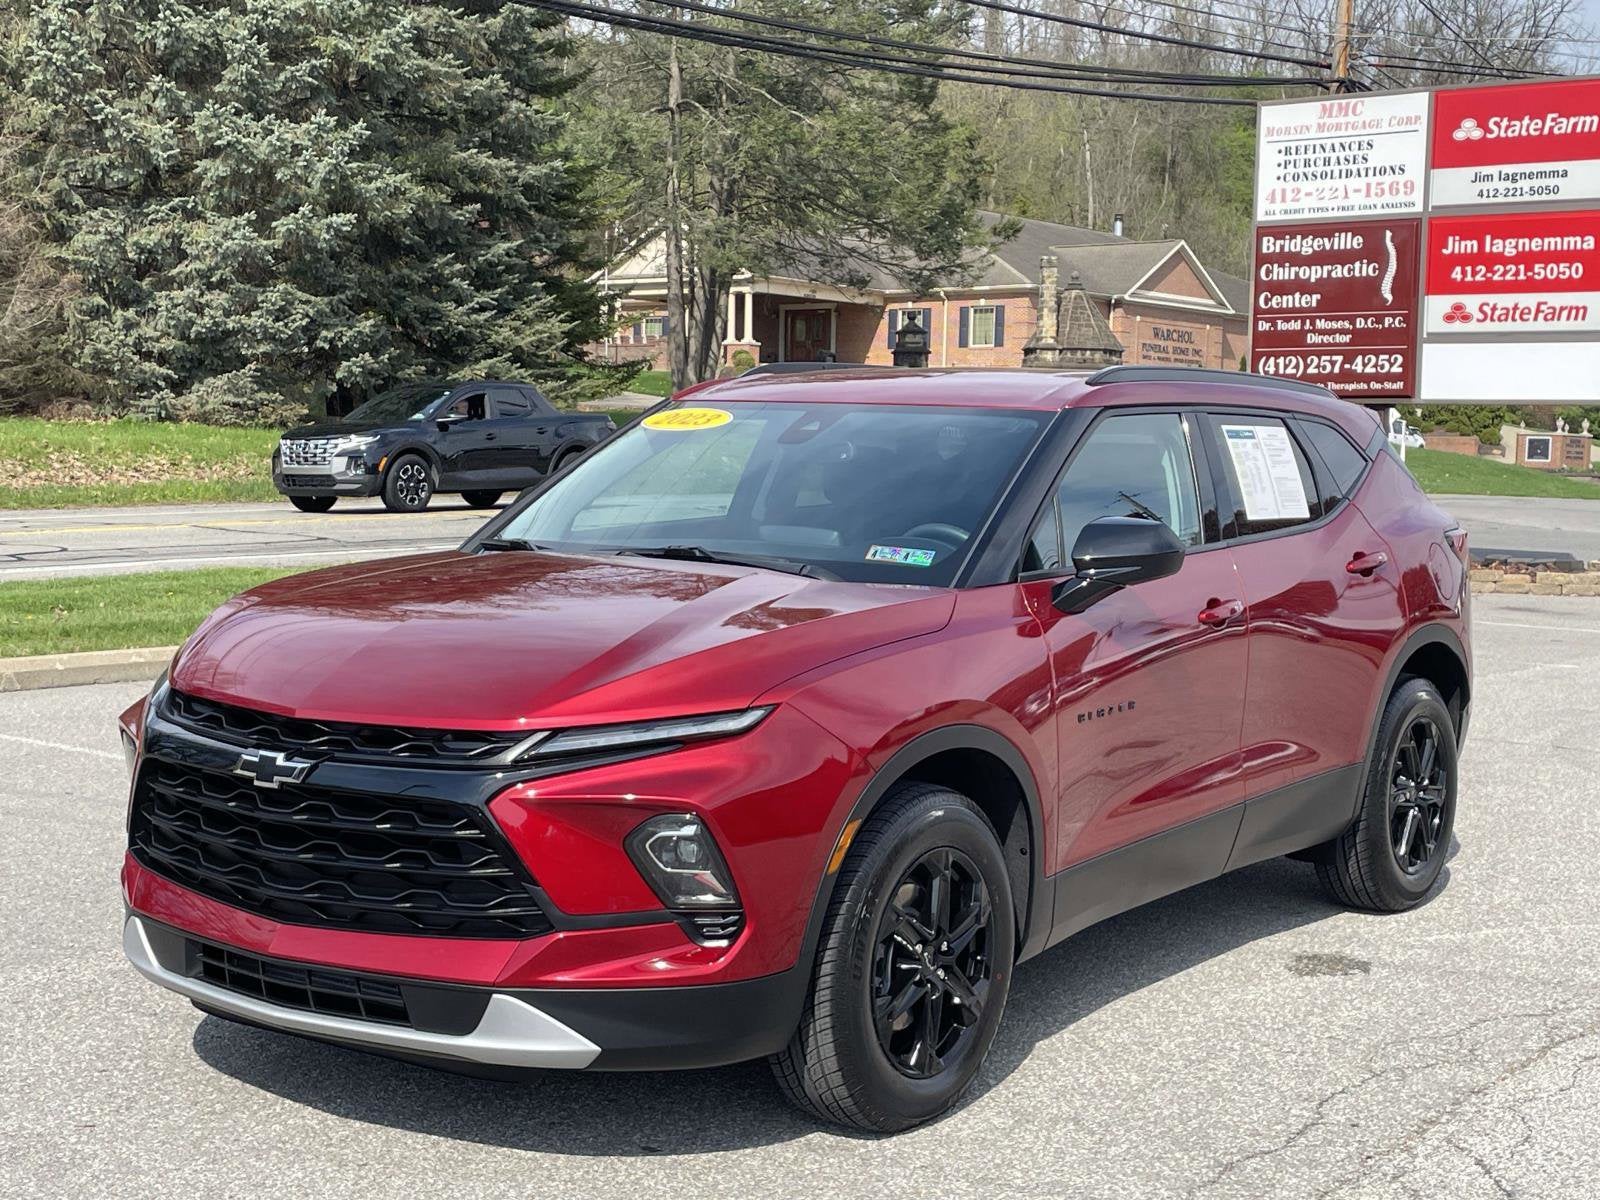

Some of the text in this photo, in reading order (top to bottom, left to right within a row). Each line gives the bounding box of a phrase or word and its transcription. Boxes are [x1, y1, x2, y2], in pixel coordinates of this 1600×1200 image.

[1318, 99, 1365, 119] MMC
[1315, 118, 1384, 133] MORTGAGE
[1388, 114, 1422, 128] CORP.
[1283, 139, 1374, 156] REFINANCES
[1283, 153, 1369, 170] PURCHASES
[1282, 164, 1406, 183] CONSOLIDATIONS
[1470, 168, 1568, 183] Jim Iagnemma
[1265, 179, 1416, 205] 412-221-1569
[1477, 184, 1560, 199] 412-221-5050
[1308, 206, 1330, 214] TYPES
[1358, 203, 1377, 211] LOAN
[1261, 231, 1364, 256] Bridgeville
[1441, 234, 1595, 257] Jim Iagnemma
[1259, 259, 1380, 283] Chiropractic
[1450, 262, 1584, 282] 412-221-5050
[1258, 291, 1322, 309] Center
[1257, 320, 1274, 331] Dr.
[1276, 319, 1301, 331] Todd
[1303, 318, 1314, 330] J.
[1315, 318, 1353, 331] Moses,
[1384, 316, 1407, 328] P.C.
[1151, 326, 1196, 344] WARCHOL
[1306, 333, 1353, 344] Director
[1258, 353, 1404, 378] (412) 257-4252
[1327, 381, 1369, 391] Therapists
[1370, 381, 1405, 390] On-Staff
